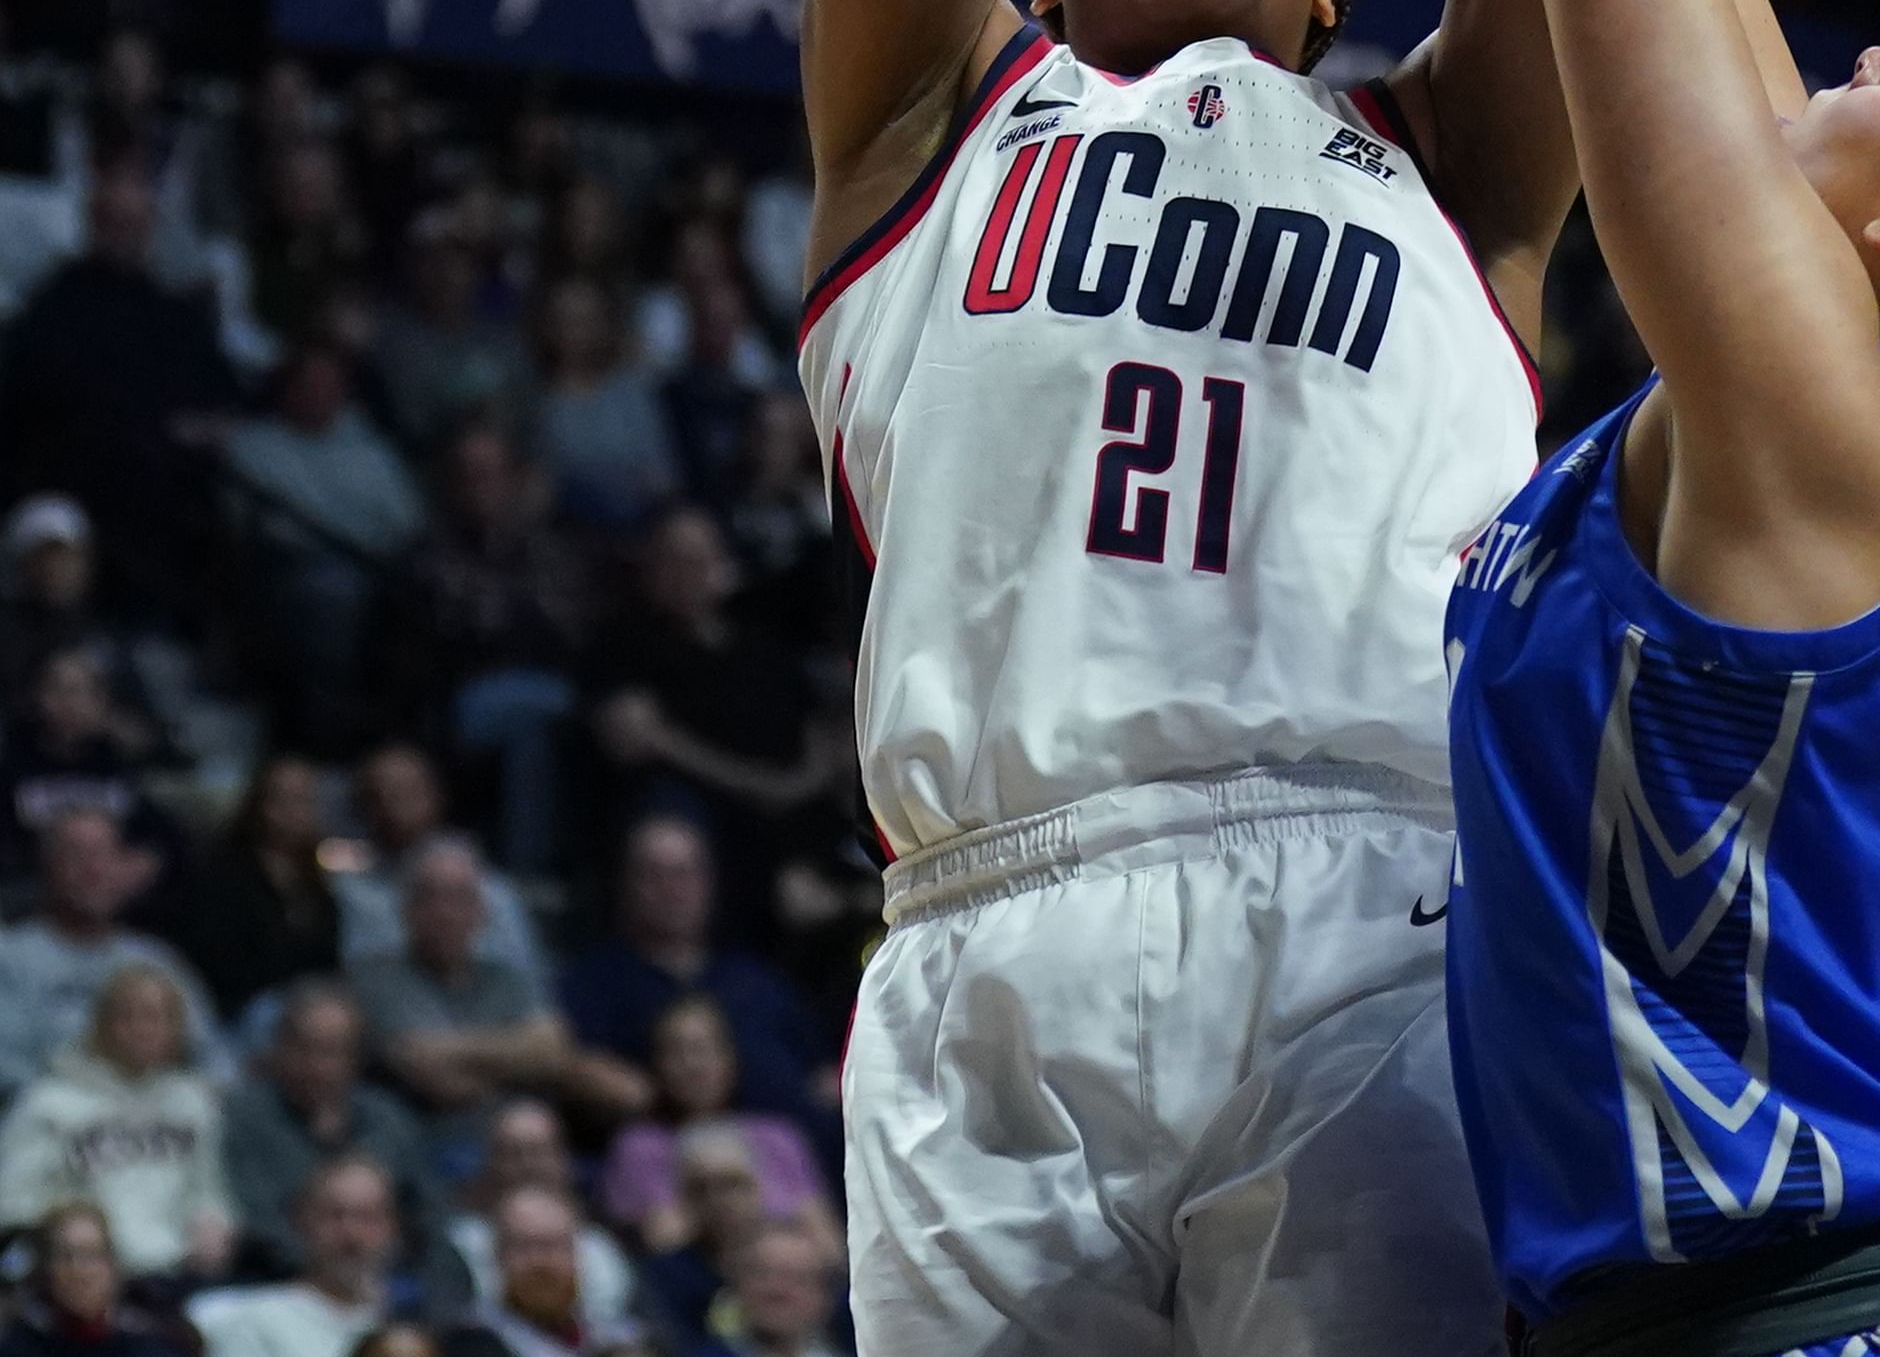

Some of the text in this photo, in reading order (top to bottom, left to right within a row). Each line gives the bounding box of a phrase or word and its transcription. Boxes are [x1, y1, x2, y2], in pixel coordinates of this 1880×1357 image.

[997, 116, 1061, 152] CHANGE
[1334, 127, 1387, 160] BIG
[1324, 140, 1397, 180] EAST
[1085, 361, 1245, 574] 21
